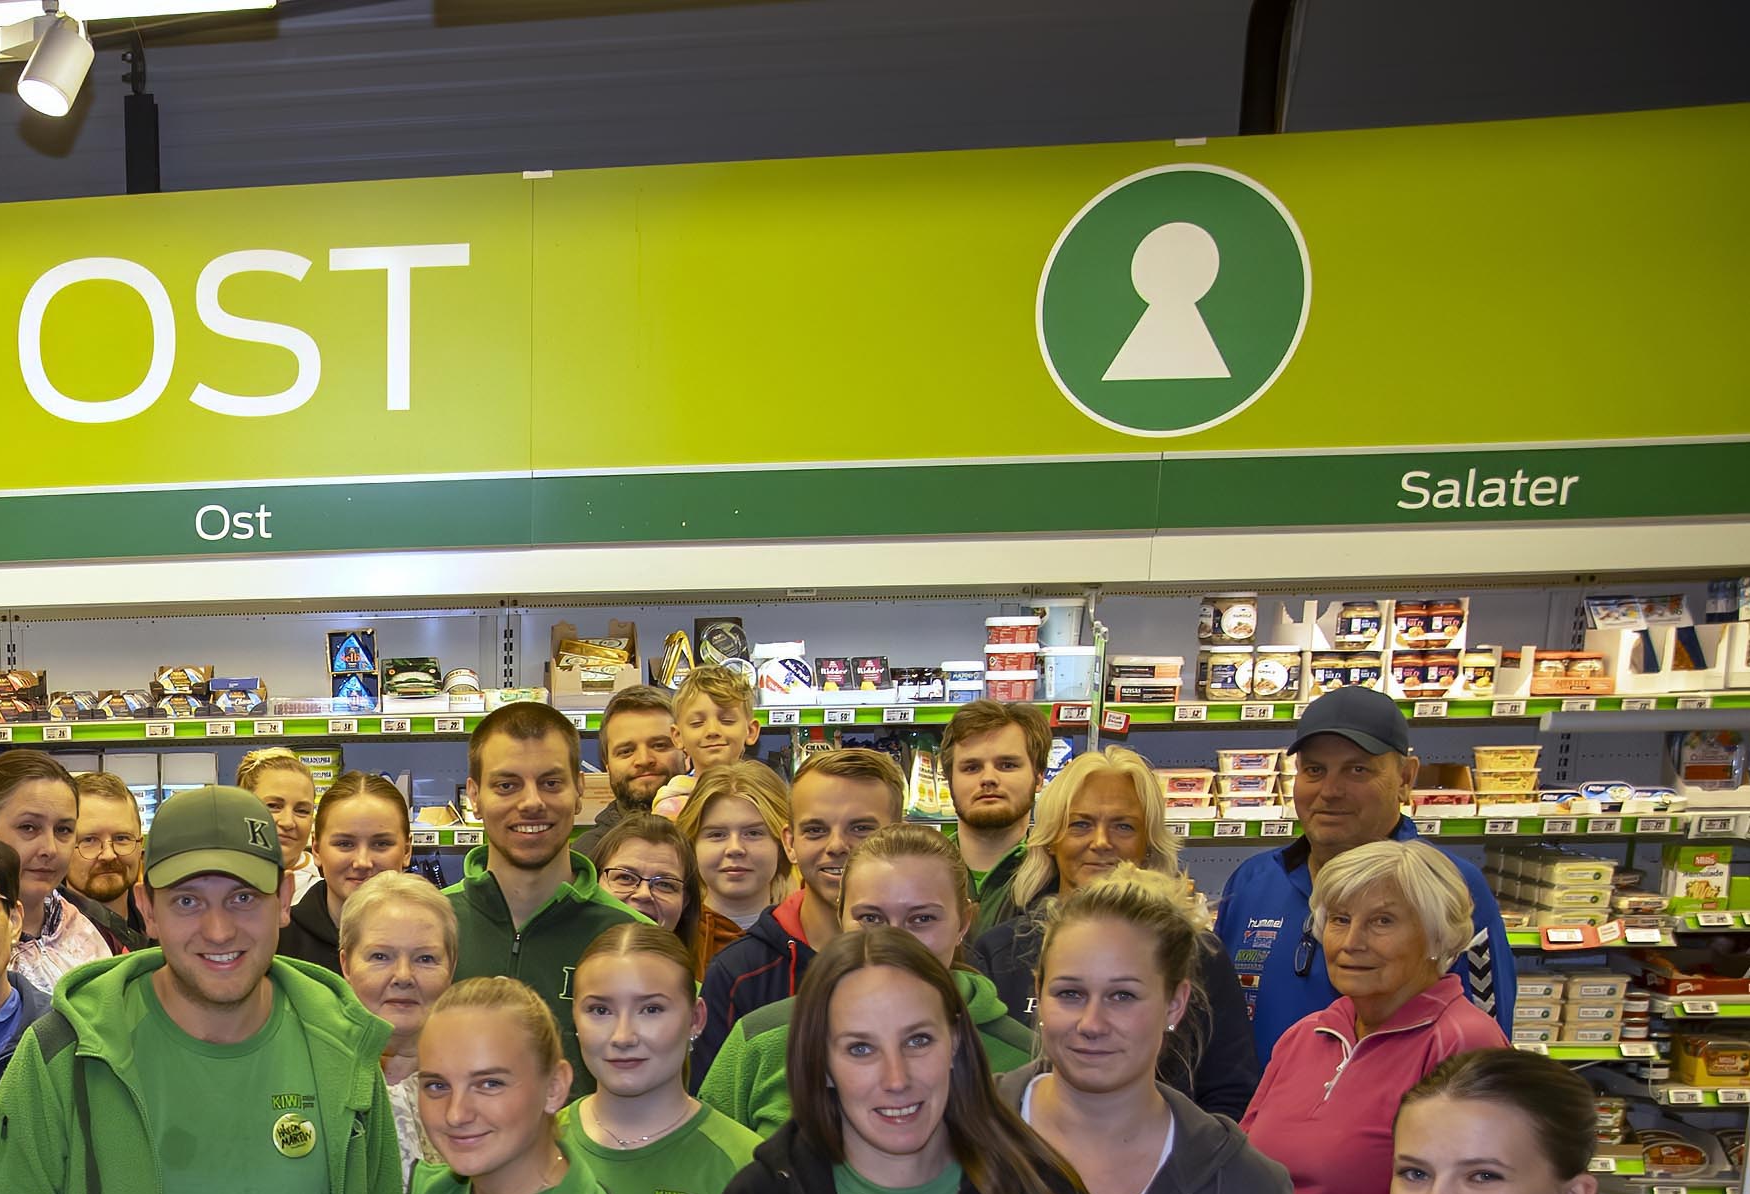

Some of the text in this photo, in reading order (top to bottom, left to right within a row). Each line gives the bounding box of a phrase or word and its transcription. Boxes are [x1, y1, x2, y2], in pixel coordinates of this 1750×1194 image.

[18, 243, 470, 424] OST
[1397, 467, 1580, 510] Salater
[195, 503, 273, 541] Ost
[244, 817, 273, 851] K
[1247, 917, 1284, 928] hummel
[272, 1093, 302, 1111] KIWI
